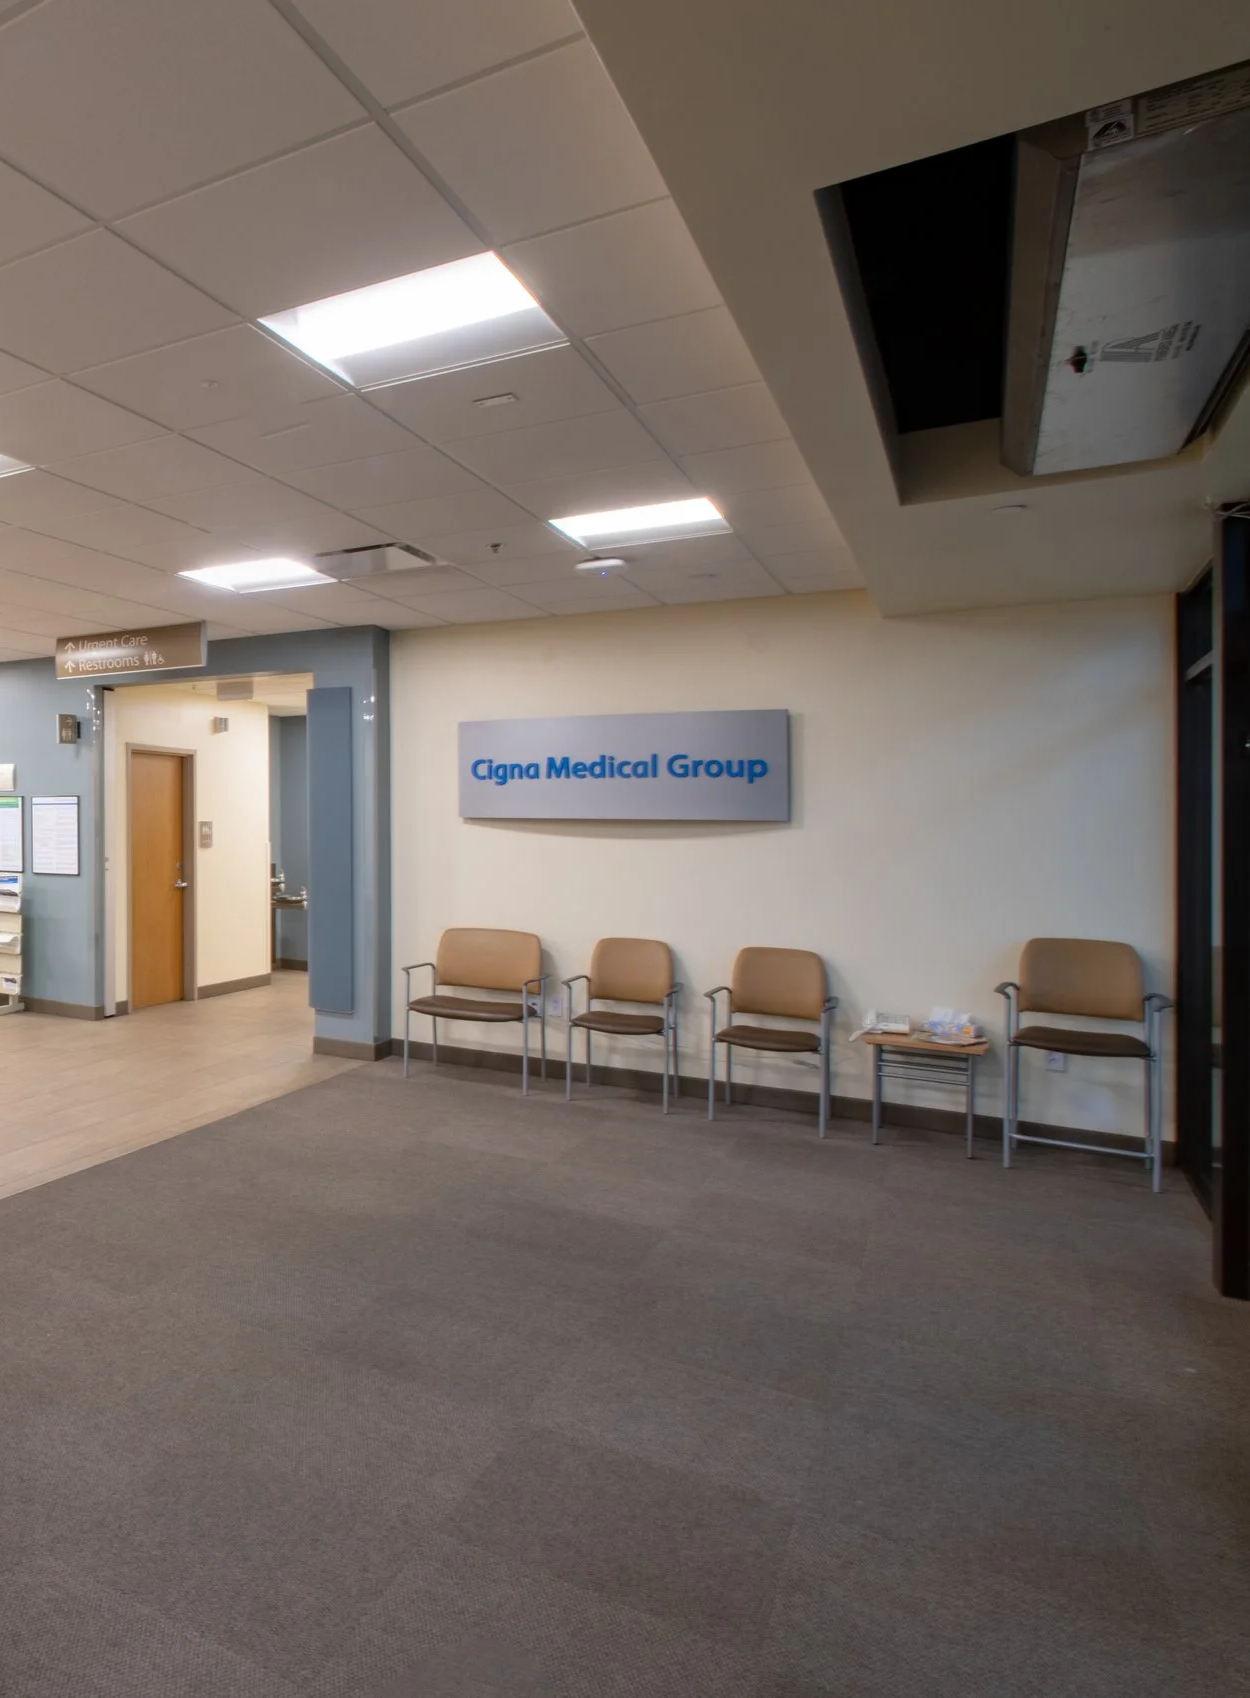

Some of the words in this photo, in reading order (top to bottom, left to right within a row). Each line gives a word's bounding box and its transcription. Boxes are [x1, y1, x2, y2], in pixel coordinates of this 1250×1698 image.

[78, 638, 118, 652] Urgent
[121, 634, 148, 648] Care
[79, 655, 140, 672] Restrooms
[470, 758, 540, 786] Cigna
[546, 753, 658, 780] Medical
[666, 753, 769, 785] Group
